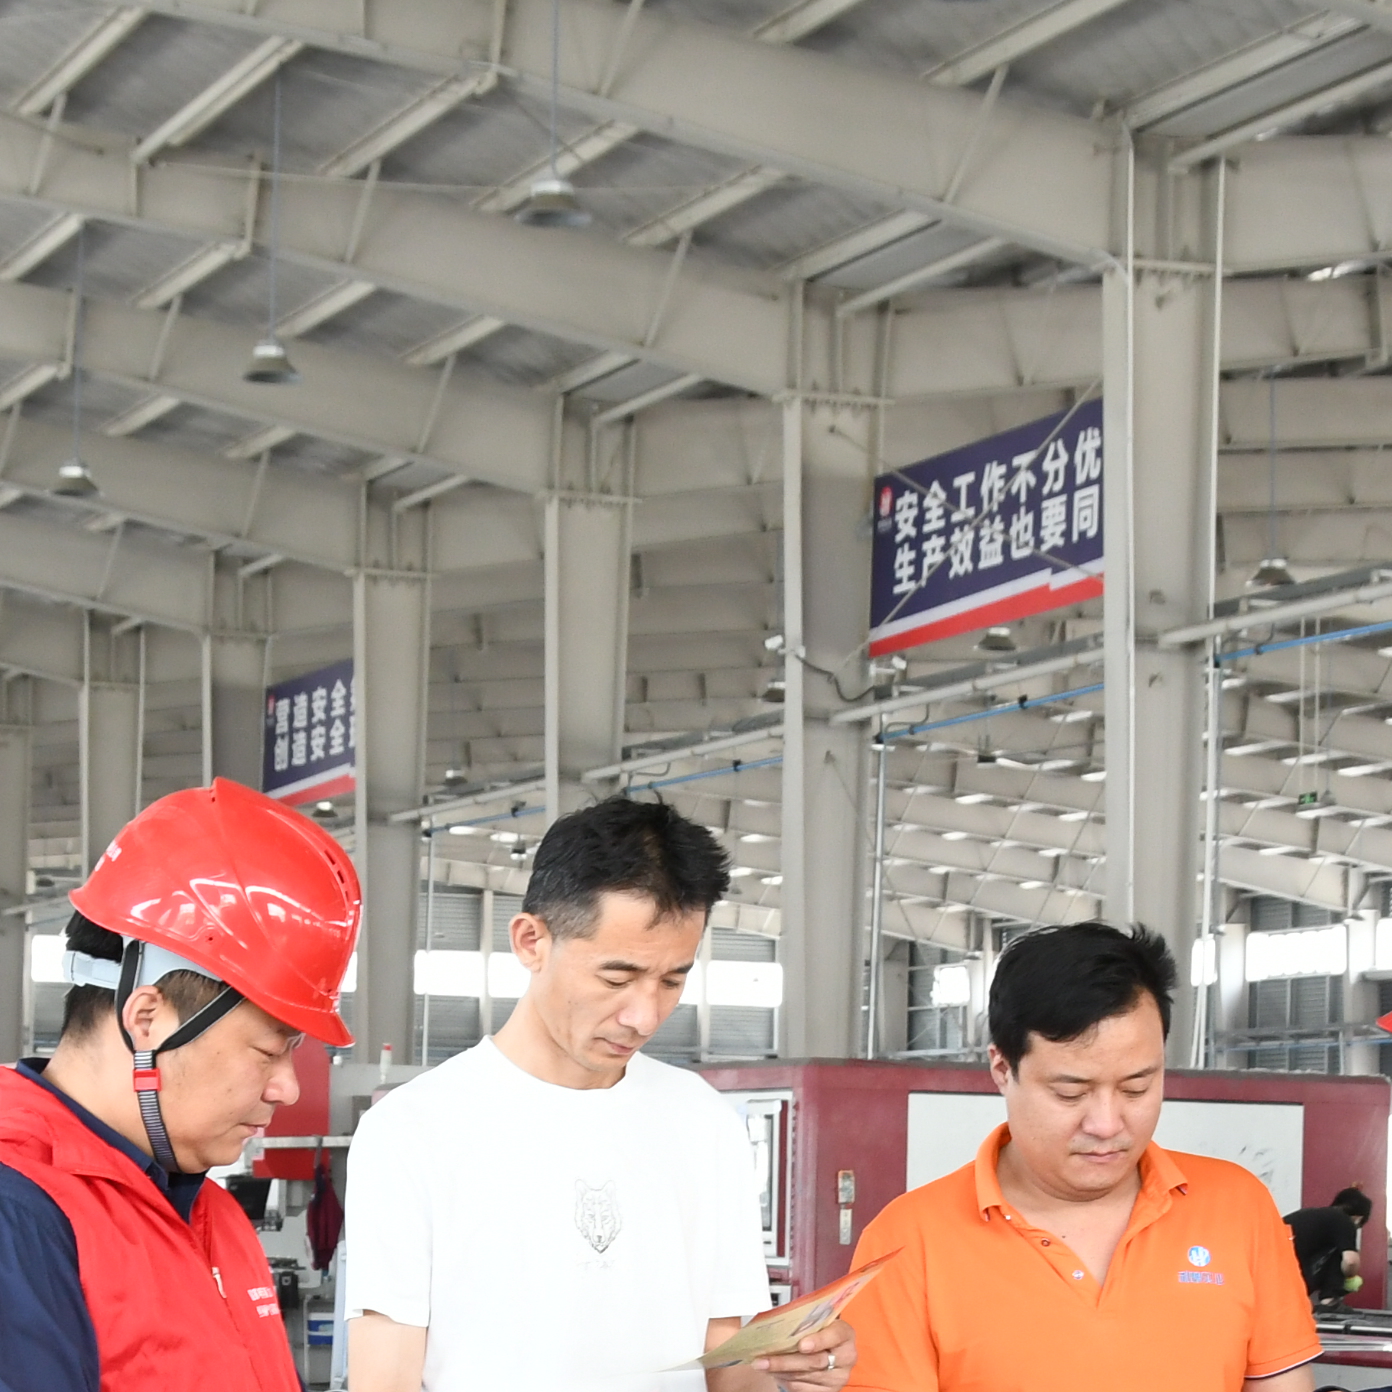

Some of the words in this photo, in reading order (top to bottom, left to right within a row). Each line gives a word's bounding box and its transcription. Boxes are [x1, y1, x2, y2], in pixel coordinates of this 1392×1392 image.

[891, 483, 1100, 596] 生产效益也要同
[893, 425, 1101, 544] 安全工作不分优
